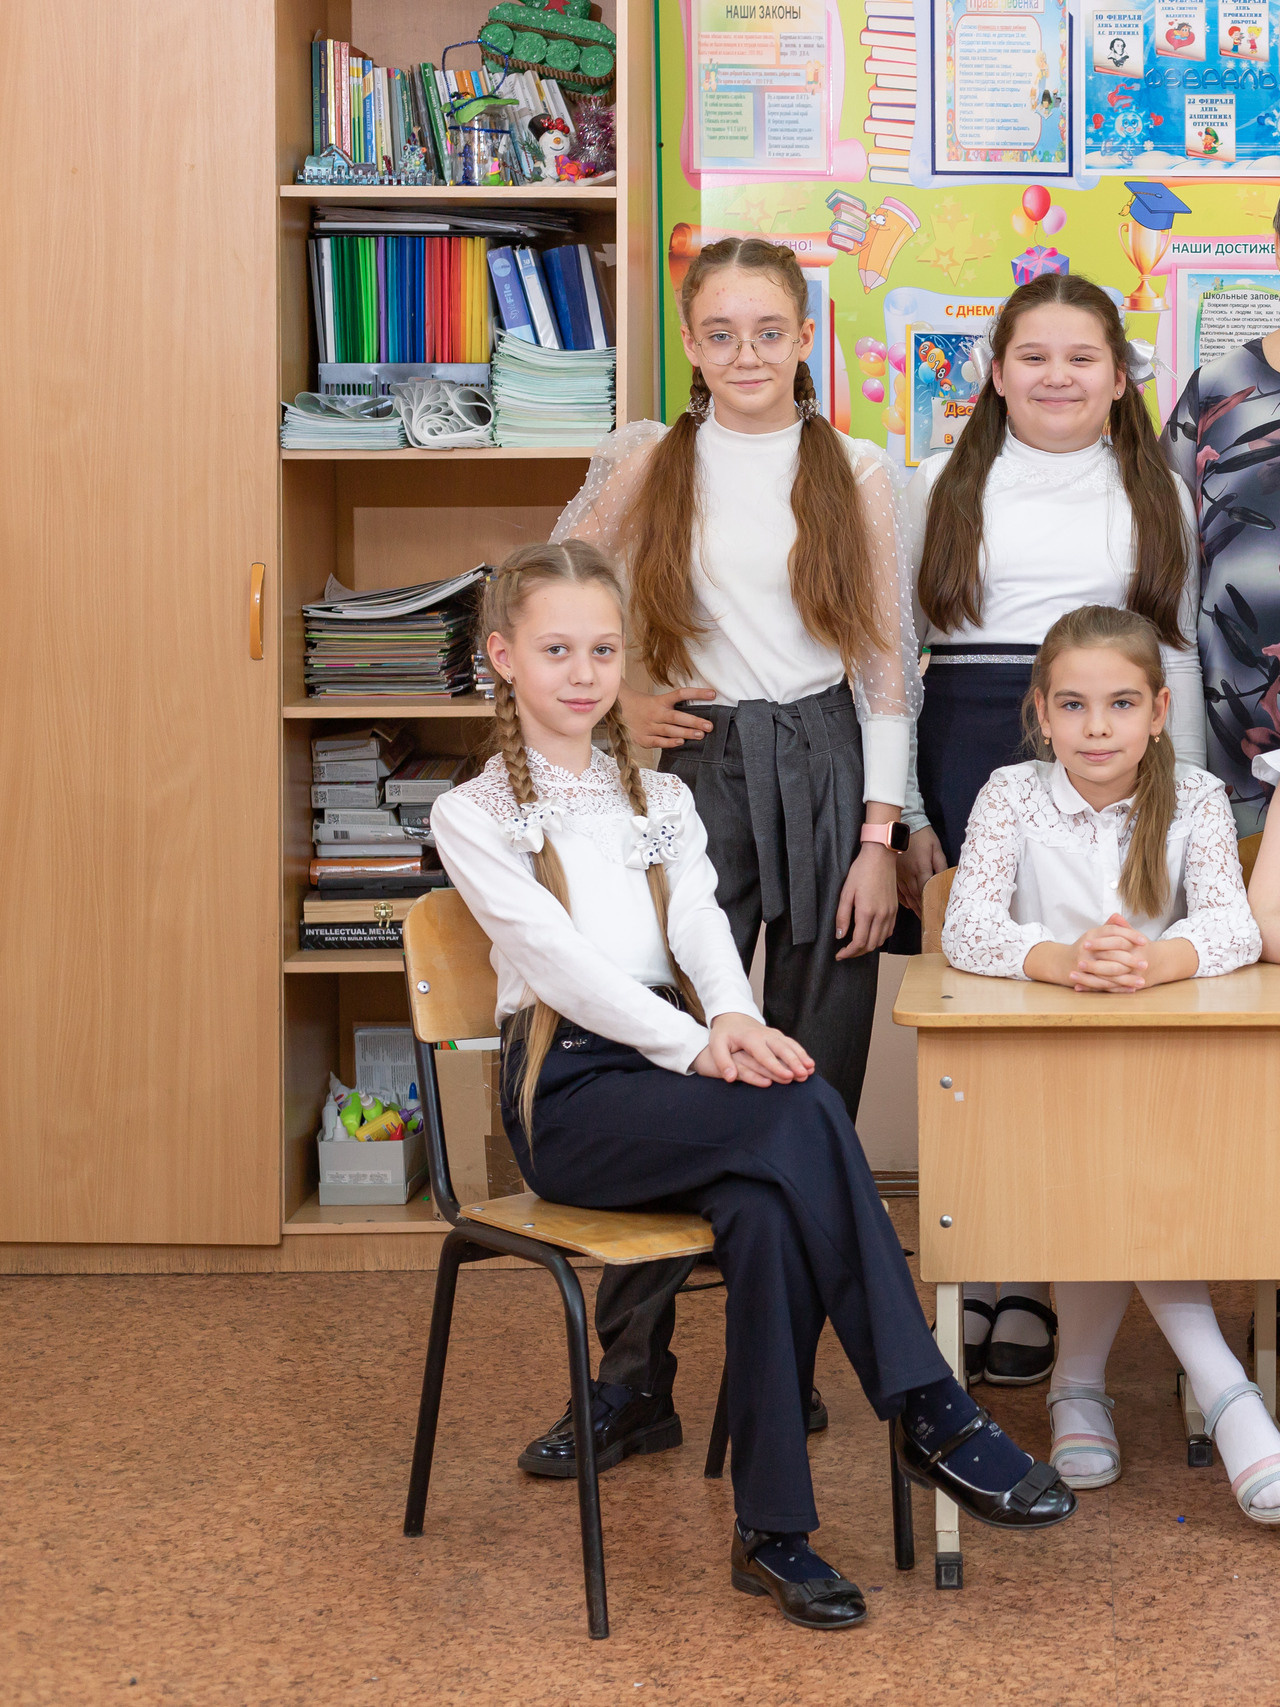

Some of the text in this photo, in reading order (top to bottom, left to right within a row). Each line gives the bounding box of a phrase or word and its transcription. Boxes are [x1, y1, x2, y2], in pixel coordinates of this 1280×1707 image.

[726, 5, 801, 20] НАШИ ЗАКОНЫ
[1144, 68, 1278, 89] ФЕВРАЛЬ
[1172, 243, 1276, 256] НАШИ ДОСТИЖЕ
[1203, 292, 1248, 300] Школьные
[945, 305, 954, 316] С
[956, 305, 995, 318] ДНЕМ
[944, 401, 974, 419] Дес
